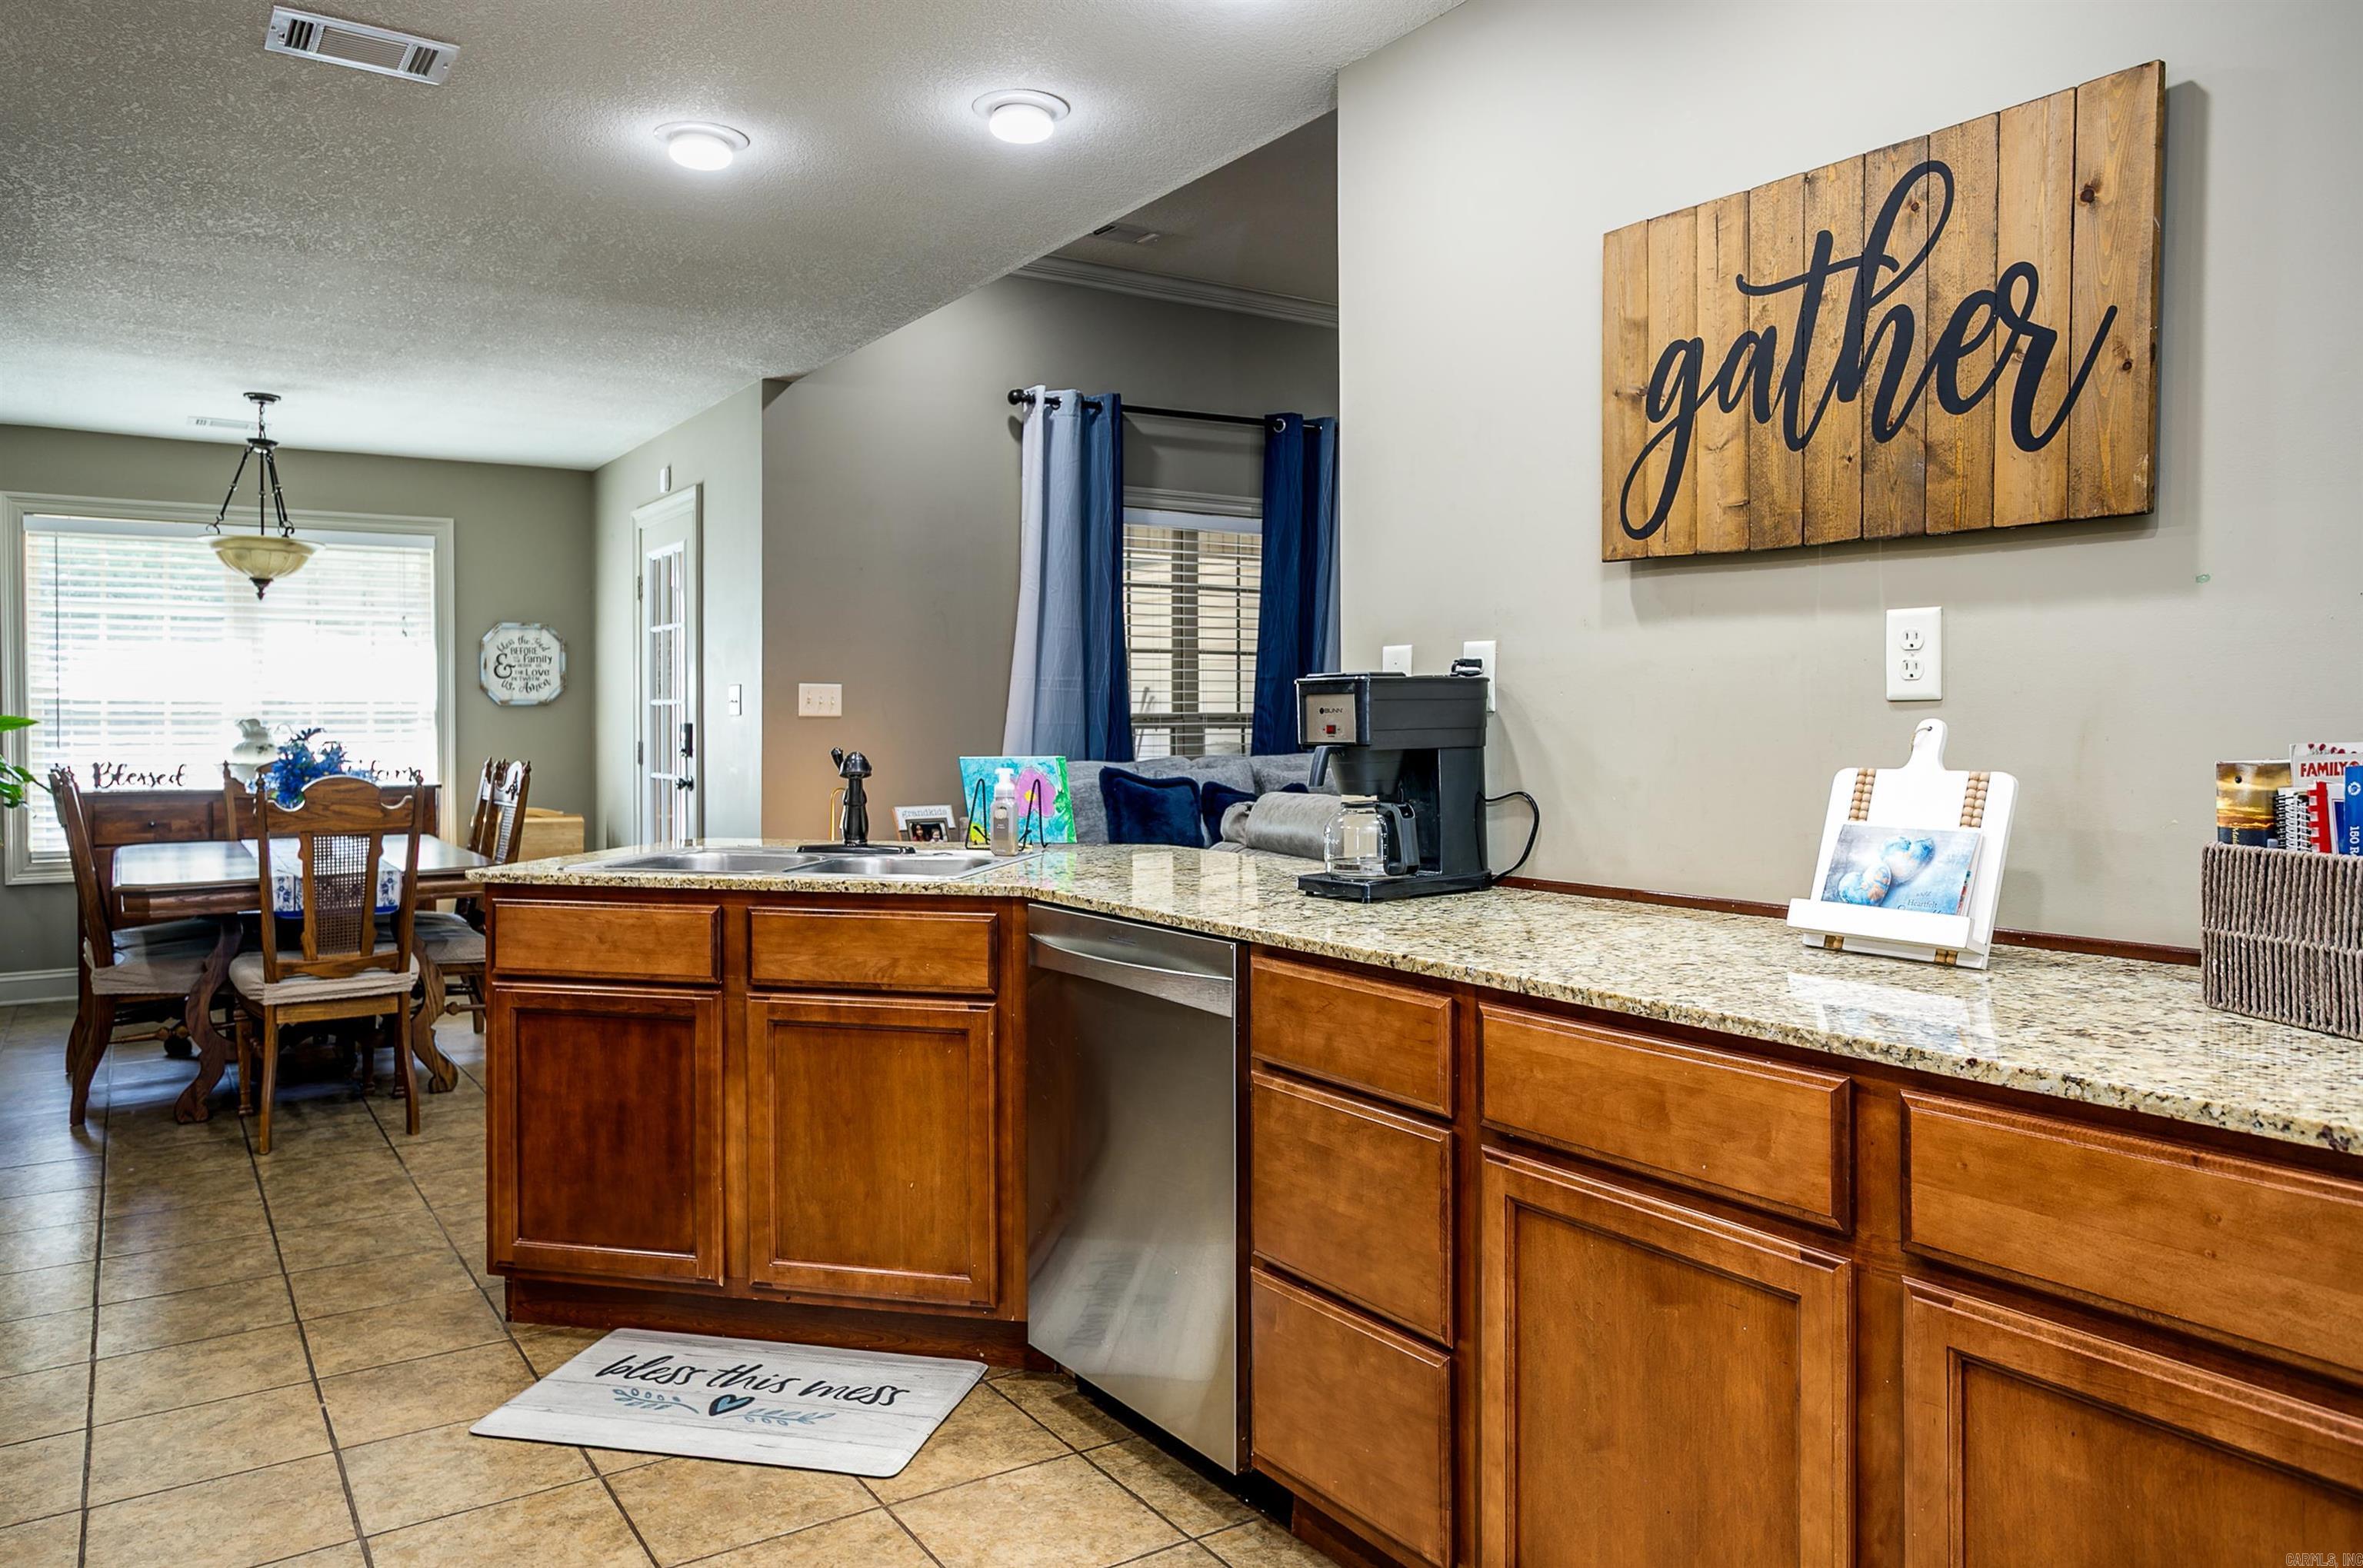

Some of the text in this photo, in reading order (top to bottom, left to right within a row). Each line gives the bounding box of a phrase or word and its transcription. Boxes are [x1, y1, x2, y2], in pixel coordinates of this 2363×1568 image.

[1619, 159, 2118, 541] gather
[518, 635, 530, 645] the
[510, 647, 537, 655] BEFORE
[494, 653, 516, 678] &
[92, 761, 188, 788] Blessed
[2300, 761, 2348, 777] FAMILY
[902, 808, 948, 819] grandkids
[2349, 826, 2360, 844] 160
[1908, 898, 1938, 909] Heartfelt
[594, 1354, 910, 1407] bless this mess
